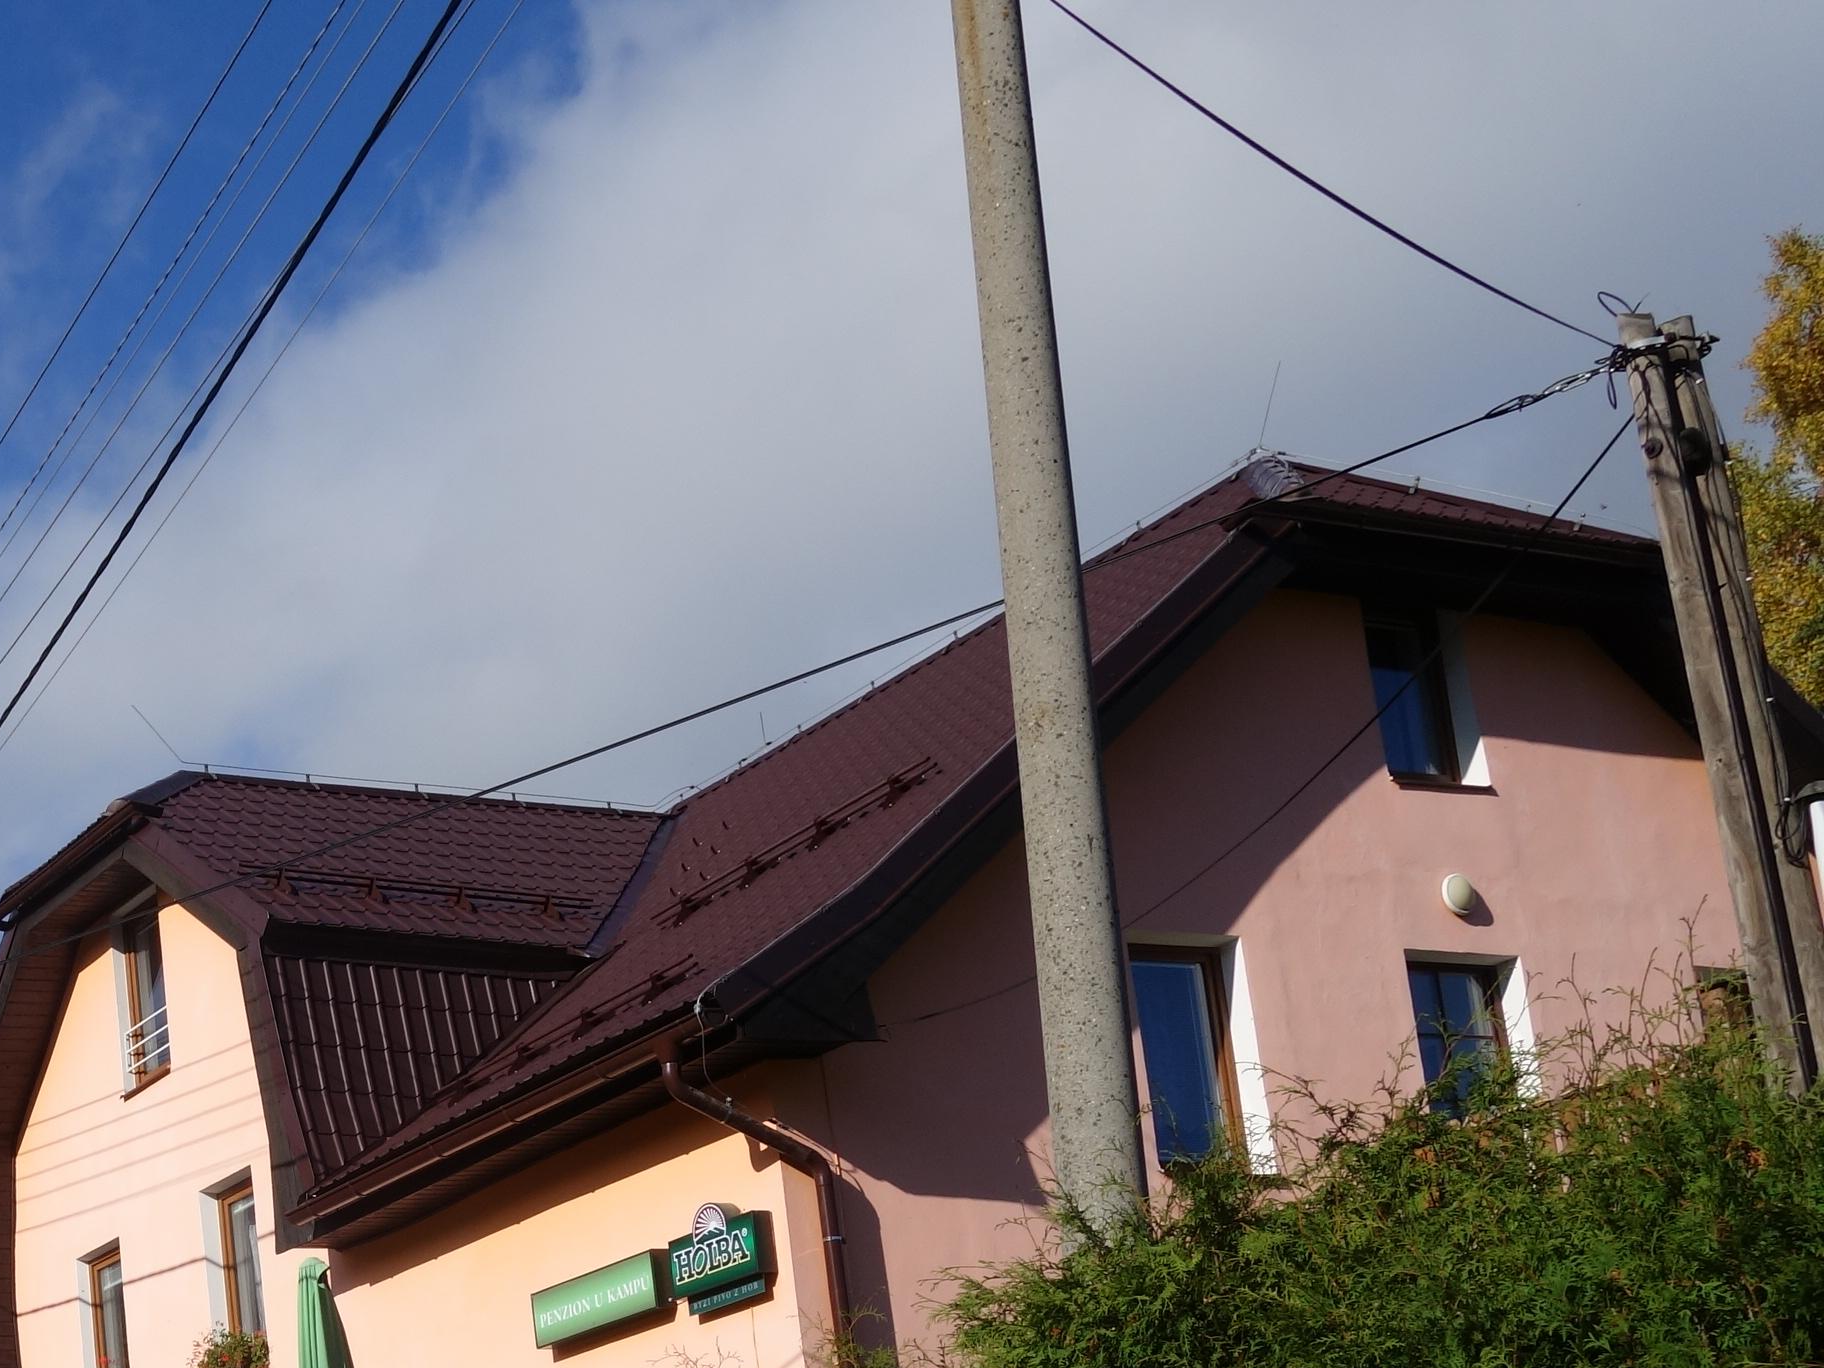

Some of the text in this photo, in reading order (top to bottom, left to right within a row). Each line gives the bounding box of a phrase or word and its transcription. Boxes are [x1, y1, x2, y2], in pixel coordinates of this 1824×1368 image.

[673, 1230, 750, 1285] HOLBA
[539, 1297, 591, 1329] PENZION
[594, 1292, 603, 1308] U
